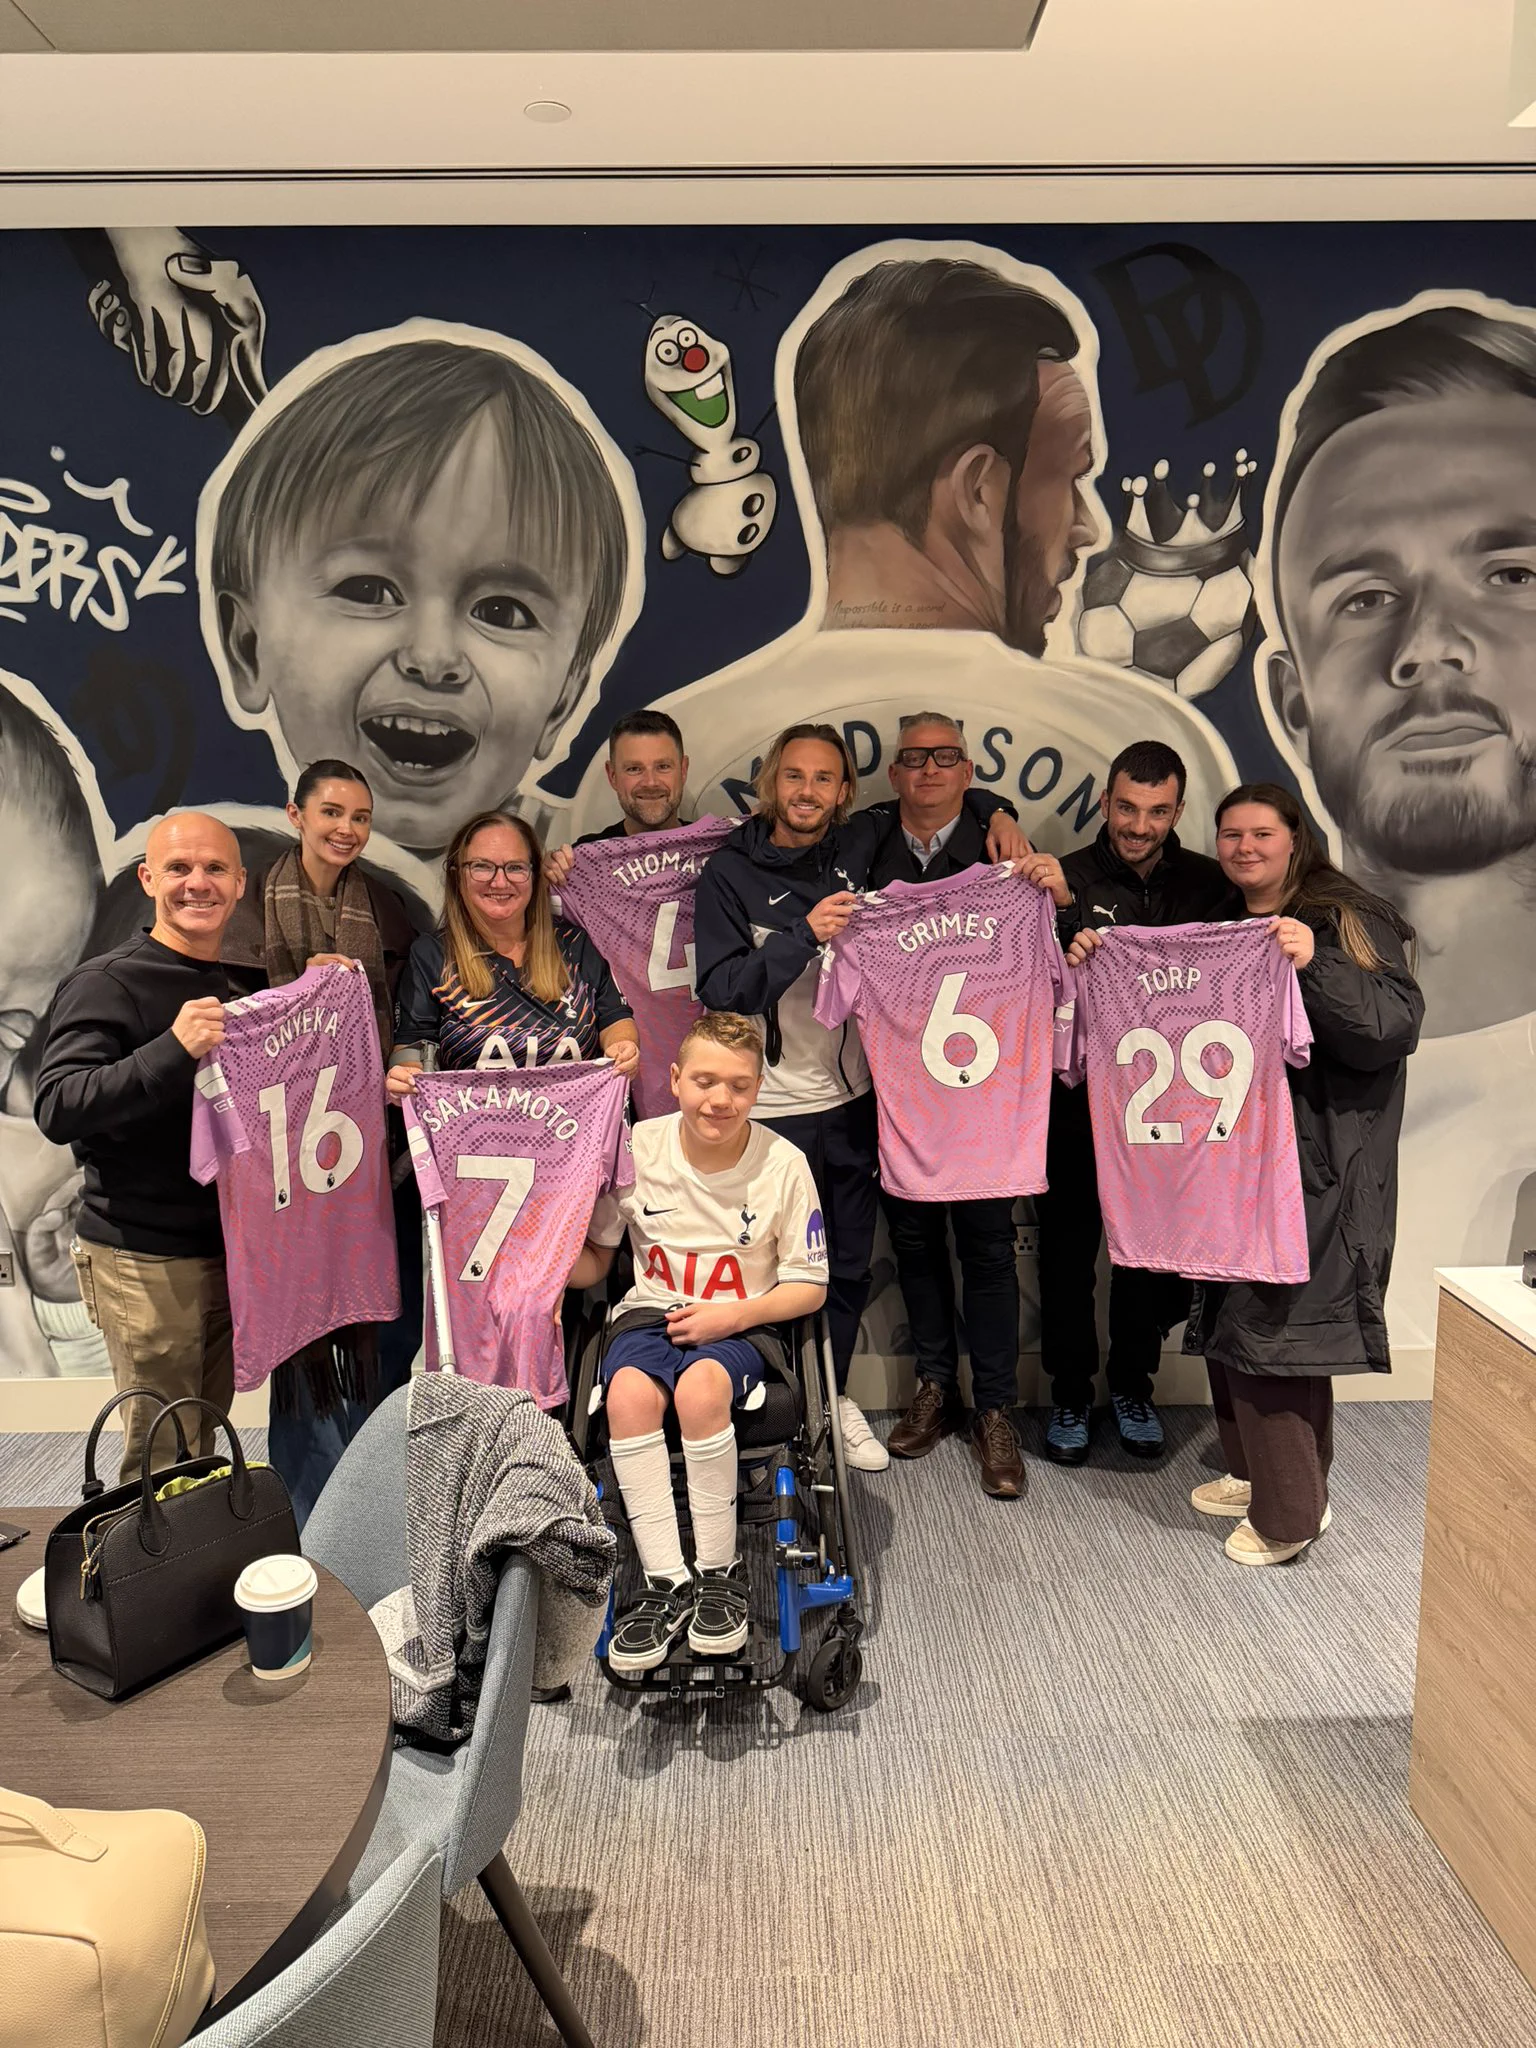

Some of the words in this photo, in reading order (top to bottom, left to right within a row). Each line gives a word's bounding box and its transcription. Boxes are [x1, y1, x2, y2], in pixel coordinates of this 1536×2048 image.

[647, 900, 701, 1002] 4
[897, 913, 998, 953] GRIMES
[1137, 966, 1201, 996] TORP
[263, 1006, 338, 1058] ONYEKA
[475, 1034, 583, 1070] AIA
[920, 971, 1000, 1089] 6
[1115, 1019, 1255, 1144] 29
[258, 1064, 364, 1213] 16
[422, 1084, 579, 1141] SAKAMOTO
[456, 1154, 536, 1282] 7
[643, 1244, 748, 1300] AIA
